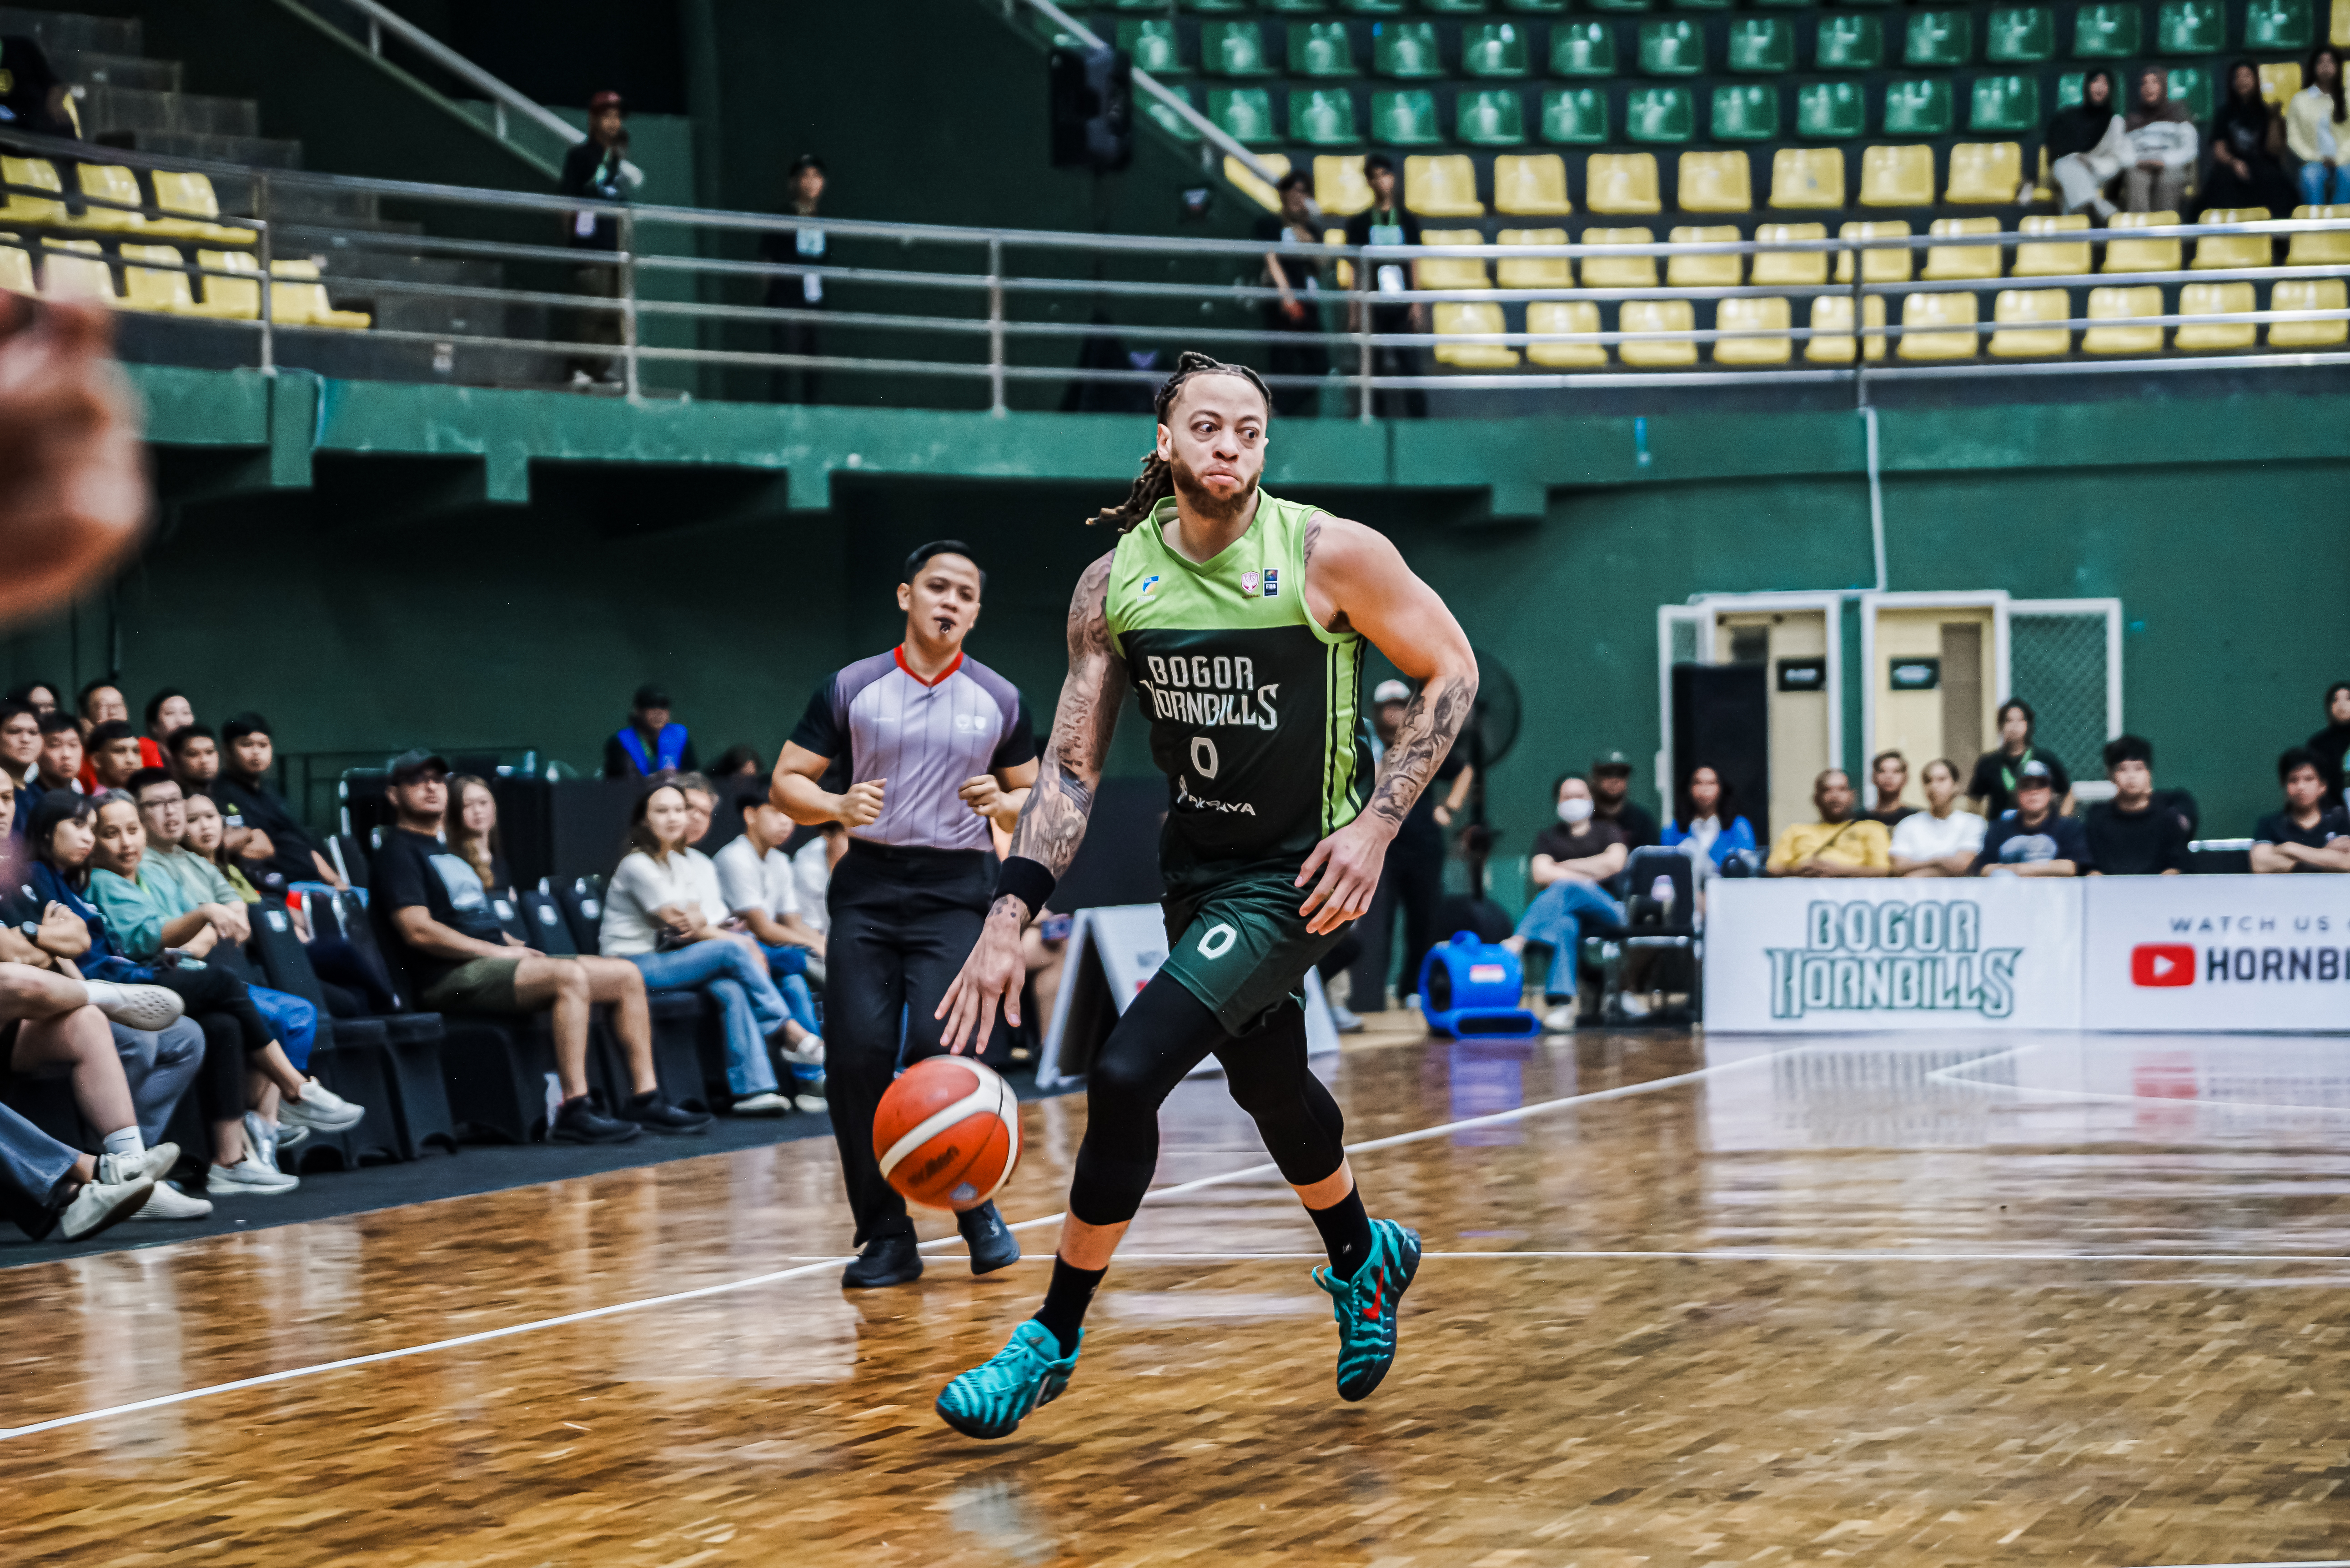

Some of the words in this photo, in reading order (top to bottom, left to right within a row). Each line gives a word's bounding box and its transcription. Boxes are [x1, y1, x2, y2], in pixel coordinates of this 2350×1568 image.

[1147, 655, 1254, 690] BOGOR
[1190, 736, 1218, 779] 0
[1197, 923, 1237, 960] 0
[1808, 900, 1980, 953] BOGOR
[2170, 915, 2277, 931] WATCH
[2295, 915, 2330, 930] US
[1763, 947, 2025, 1019] HORNBILLS
